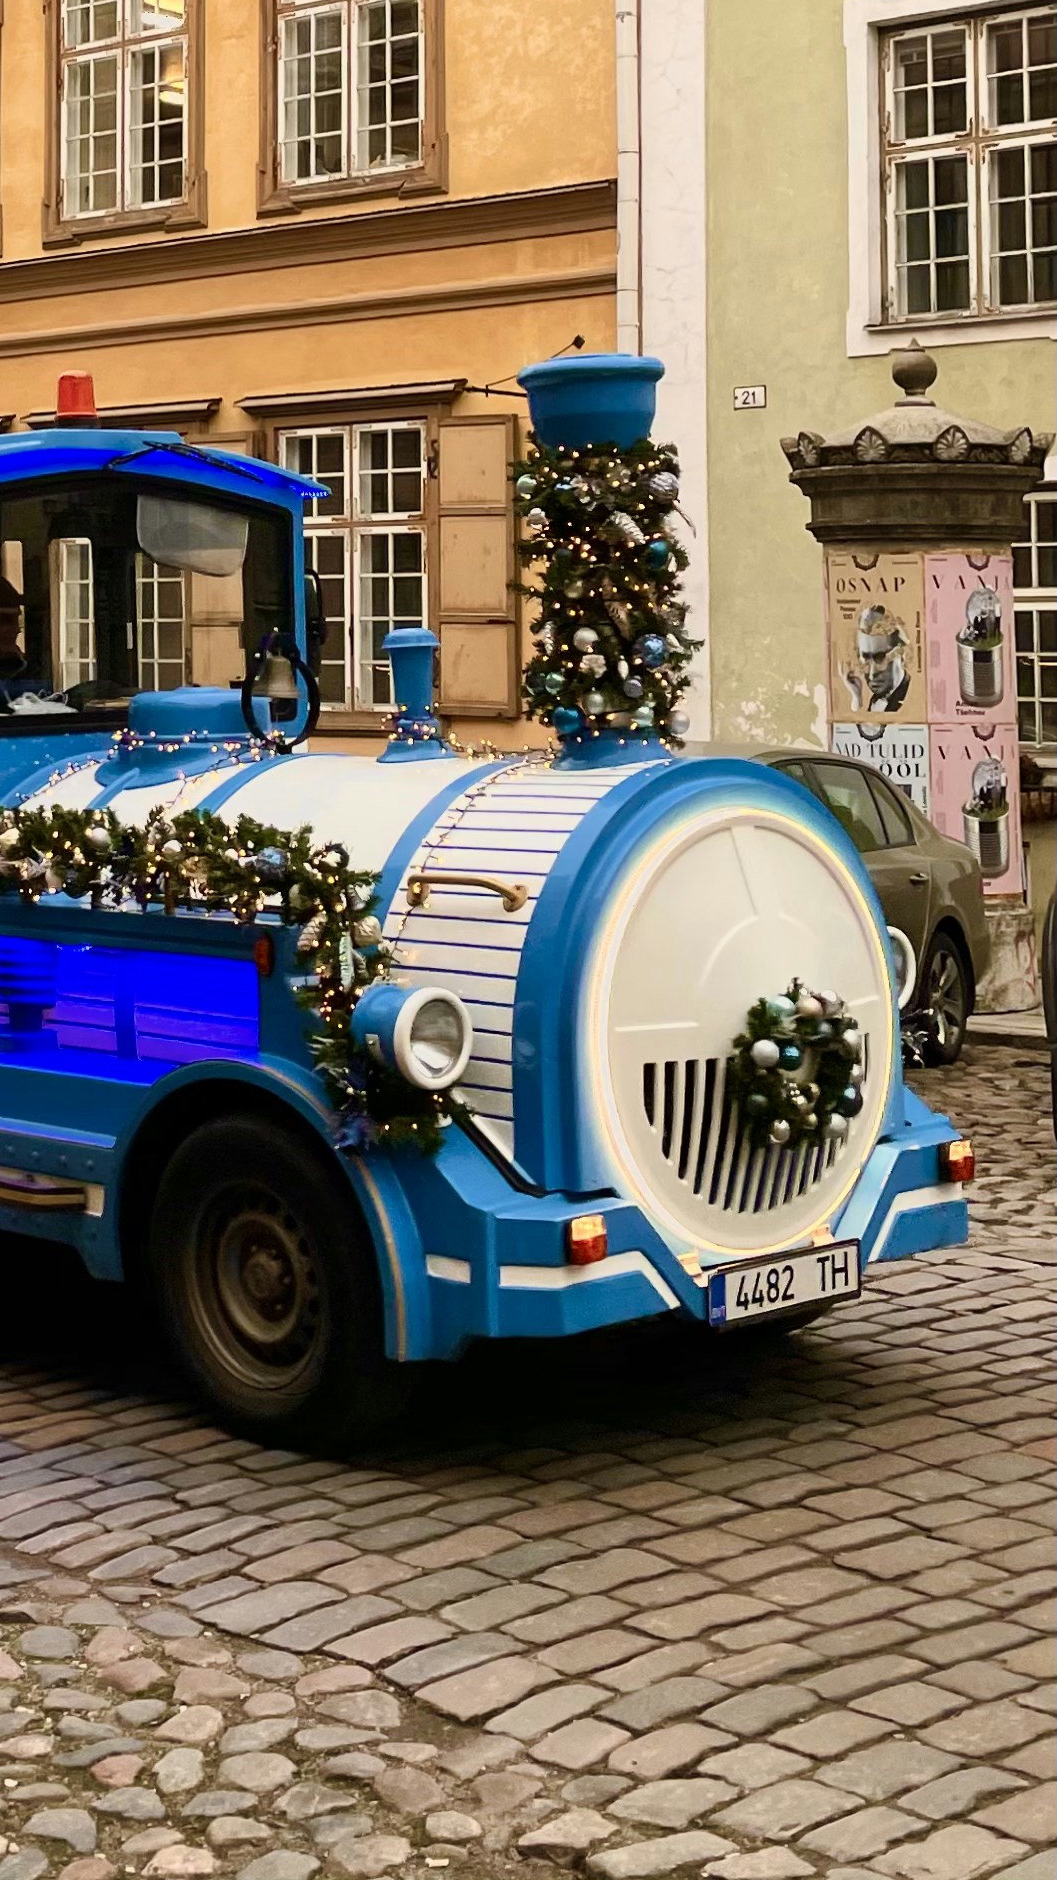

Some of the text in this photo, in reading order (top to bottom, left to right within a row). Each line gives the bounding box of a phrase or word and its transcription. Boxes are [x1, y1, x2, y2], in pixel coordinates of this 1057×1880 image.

[741, 390, 757, 405] 21
[836, 577, 906, 594] OSNAP
[866, 743, 925, 760] TULID
[736, 1251, 849, 1311] 4482 TH
